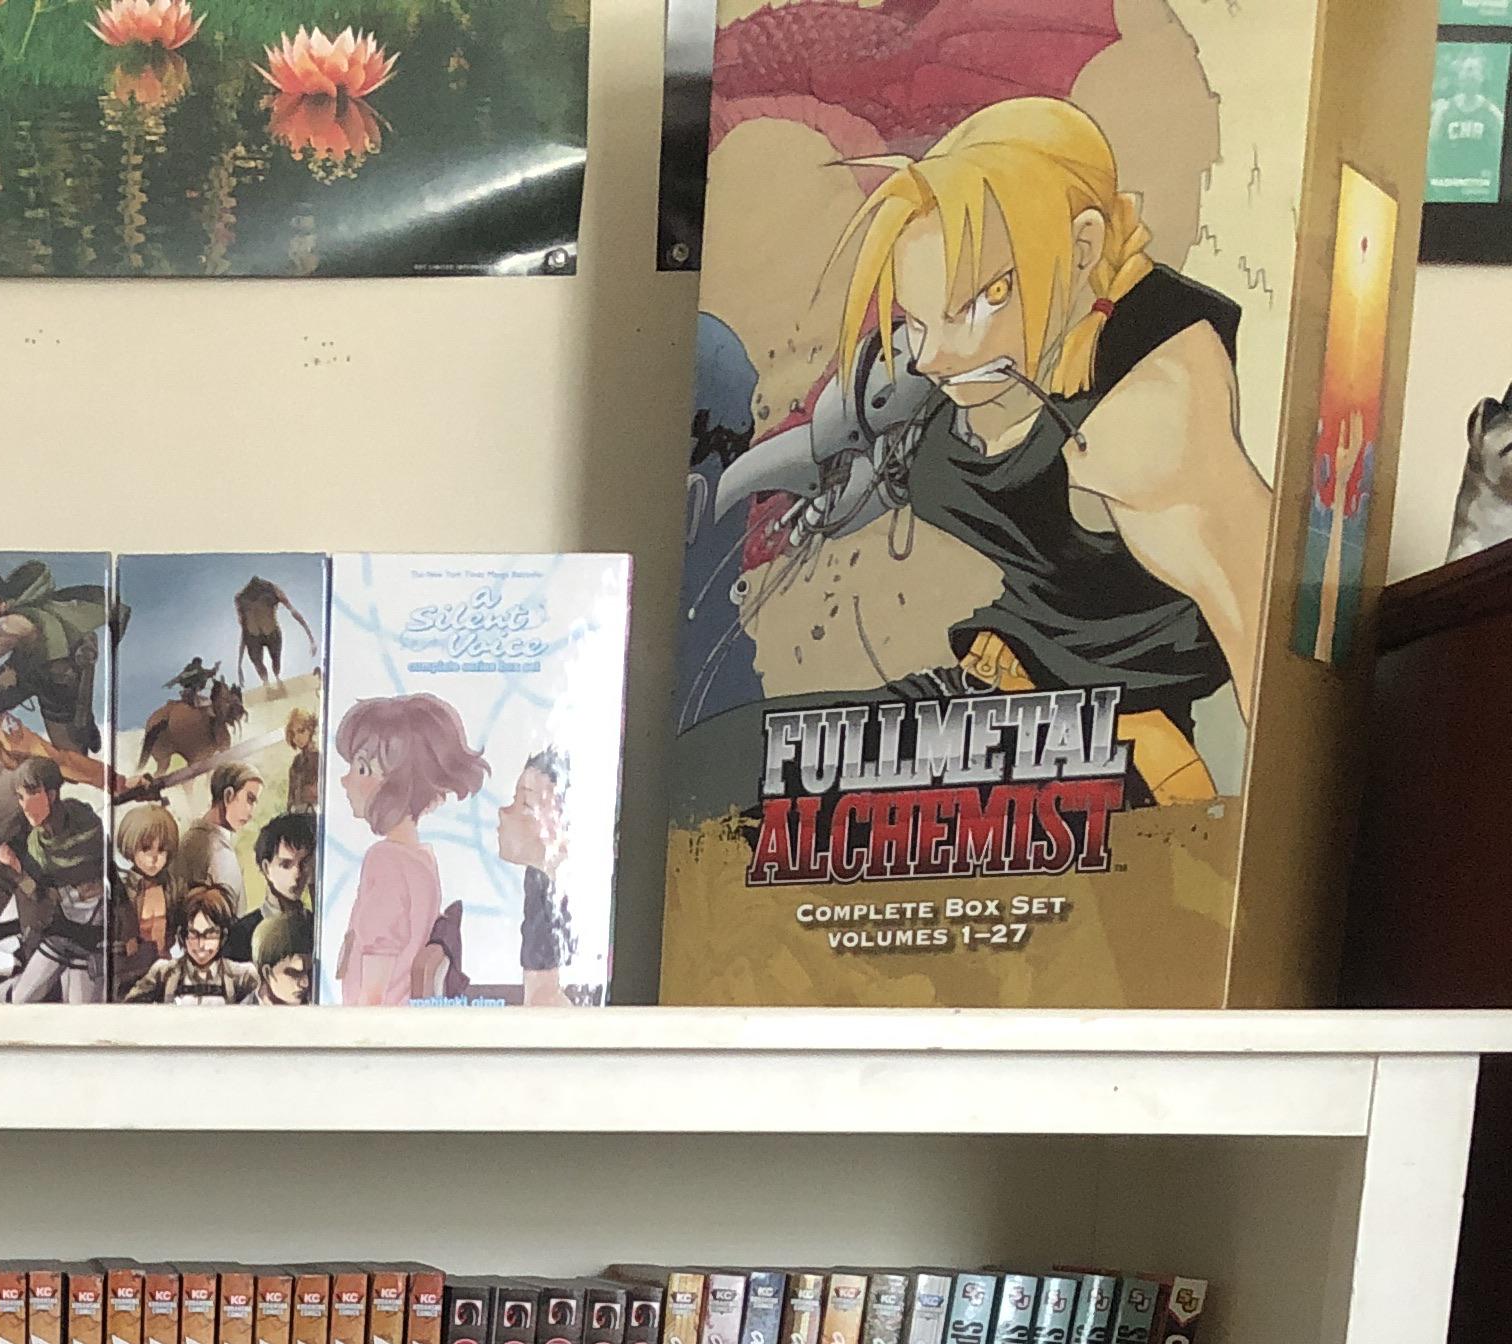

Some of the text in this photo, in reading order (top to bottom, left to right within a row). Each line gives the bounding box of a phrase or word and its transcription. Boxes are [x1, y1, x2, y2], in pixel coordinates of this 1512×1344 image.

[472, 586, 502, 609] a
[407, 604, 530, 631] Silent
[448, 633, 549, 658] Voice
[762, 686, 1129, 796] FULLMETAL
[747, 778, 1124, 886] ALCHEMIST
[796, 902, 934, 922] COMPLETE
[828, 929, 948, 949] VOLUMES
[117, 1288, 133, 1297] KC
